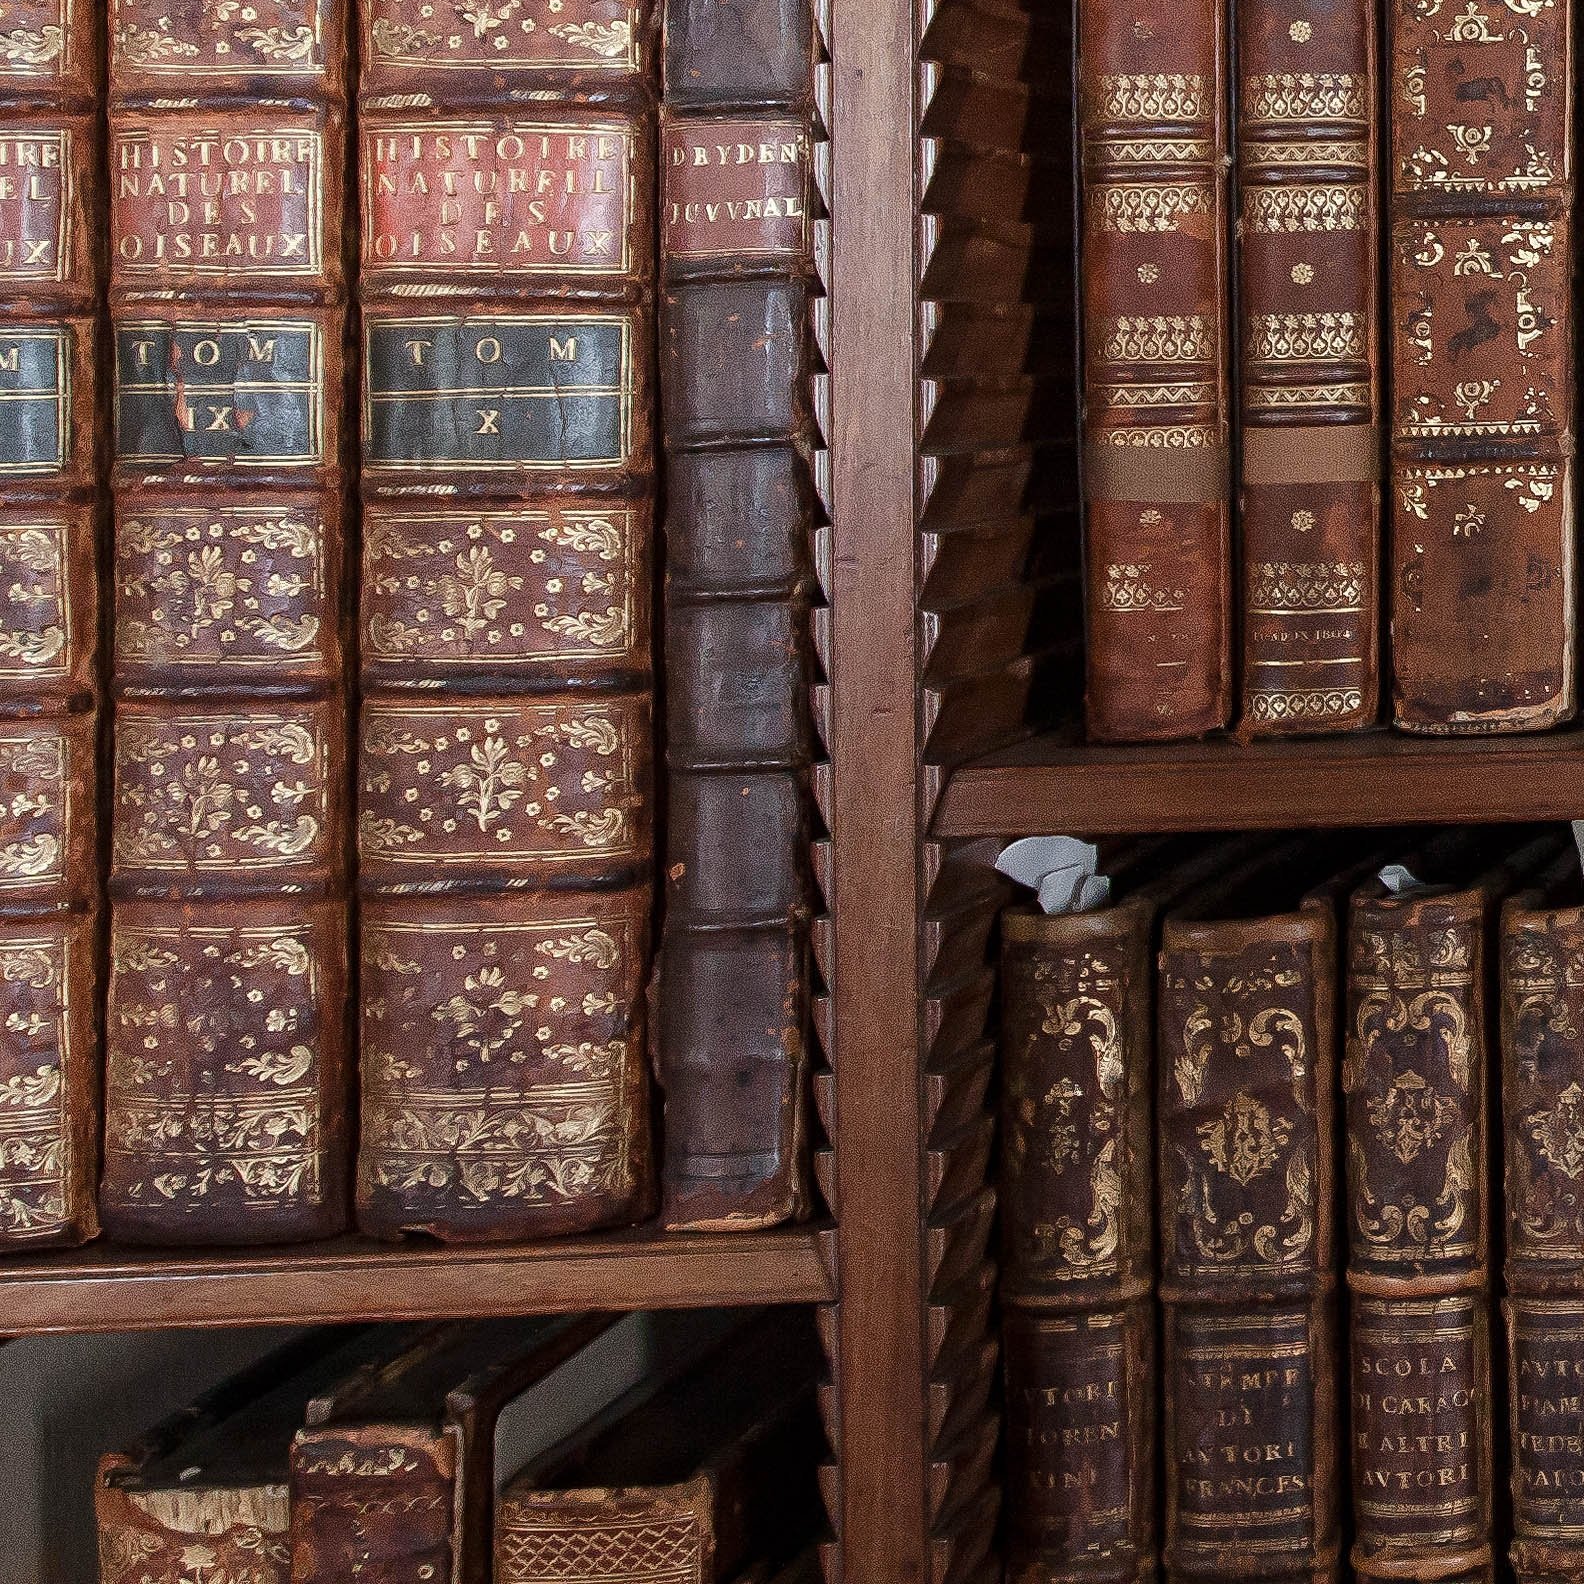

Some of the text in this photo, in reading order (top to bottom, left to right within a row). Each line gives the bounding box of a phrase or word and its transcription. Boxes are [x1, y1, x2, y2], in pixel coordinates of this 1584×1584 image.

[376, 135, 619, 161] HISTOIRE
[120, 171, 302, 197] NATUREL
[168, 202, 257, 224] DES
[440, 201, 544, 226] DES
[120, 234, 304, 258] OISEAUX
[375, 231, 612, 258] OISEAUX
[134, 340, 276, 366] TOM
[406, 338, 576, 364] TOM
[478, 410, 498, 434] X
